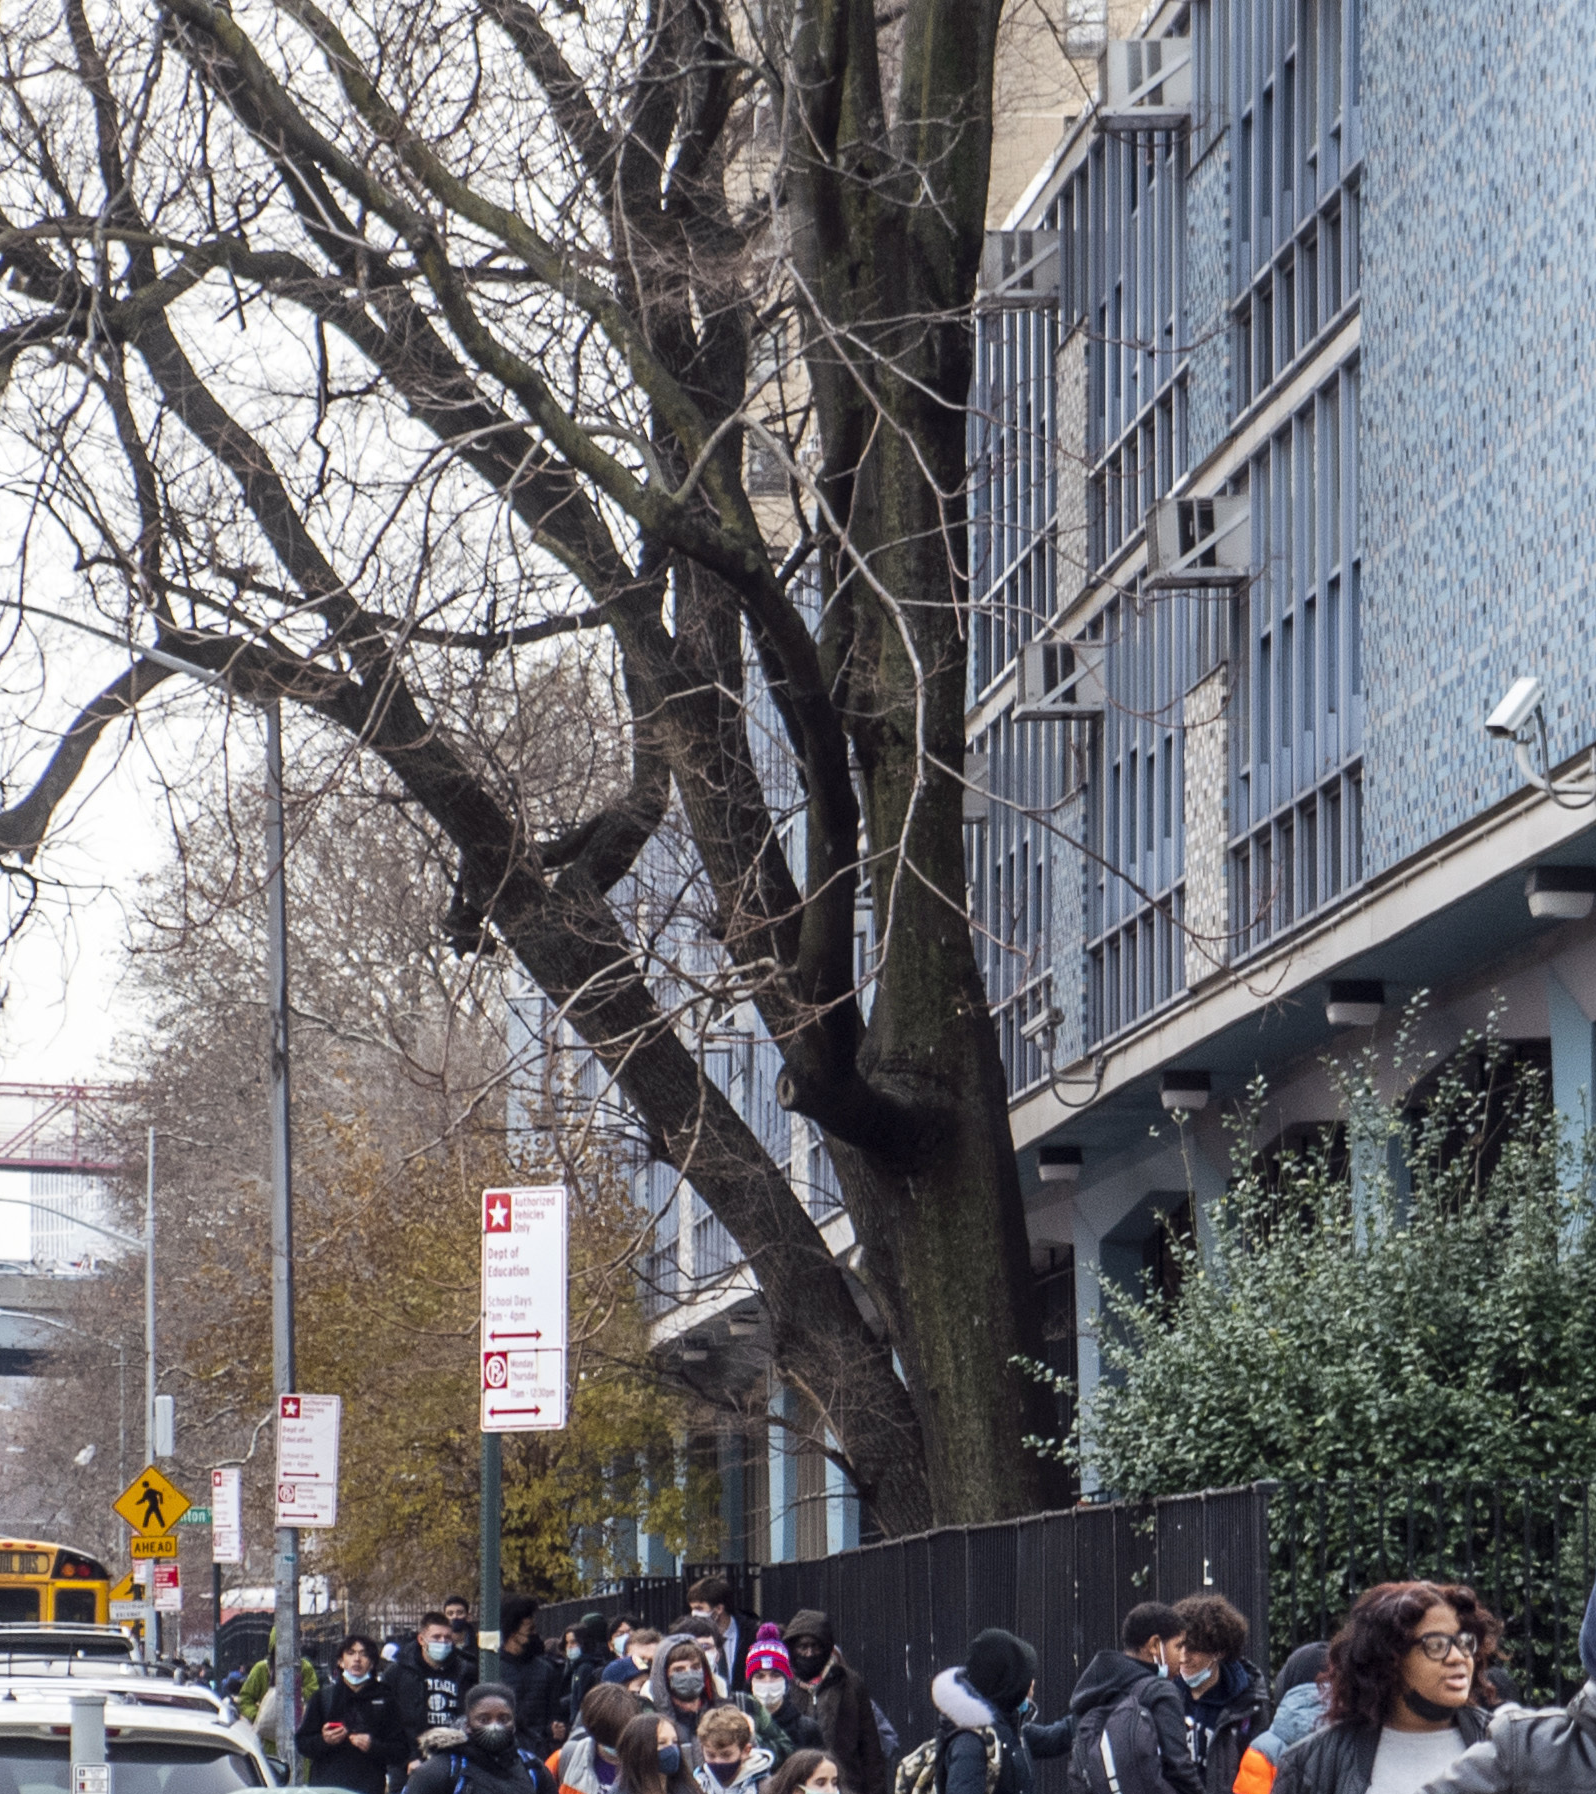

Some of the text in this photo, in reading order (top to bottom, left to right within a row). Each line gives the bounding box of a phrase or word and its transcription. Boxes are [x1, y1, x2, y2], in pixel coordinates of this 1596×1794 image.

[515, 1196, 556, 1207] Authorized
[514, 1210, 545, 1220] Vehicles
[514, 1222, 531, 1235] Only
[488, 1247, 520, 1261] Dept of
[488, 1265, 530, 1278] Education
[488, 1296, 532, 1309] School Days
[510, 1310, 526, 1322] 4pm
[134, 1542, 173, 1555] AHEAD
